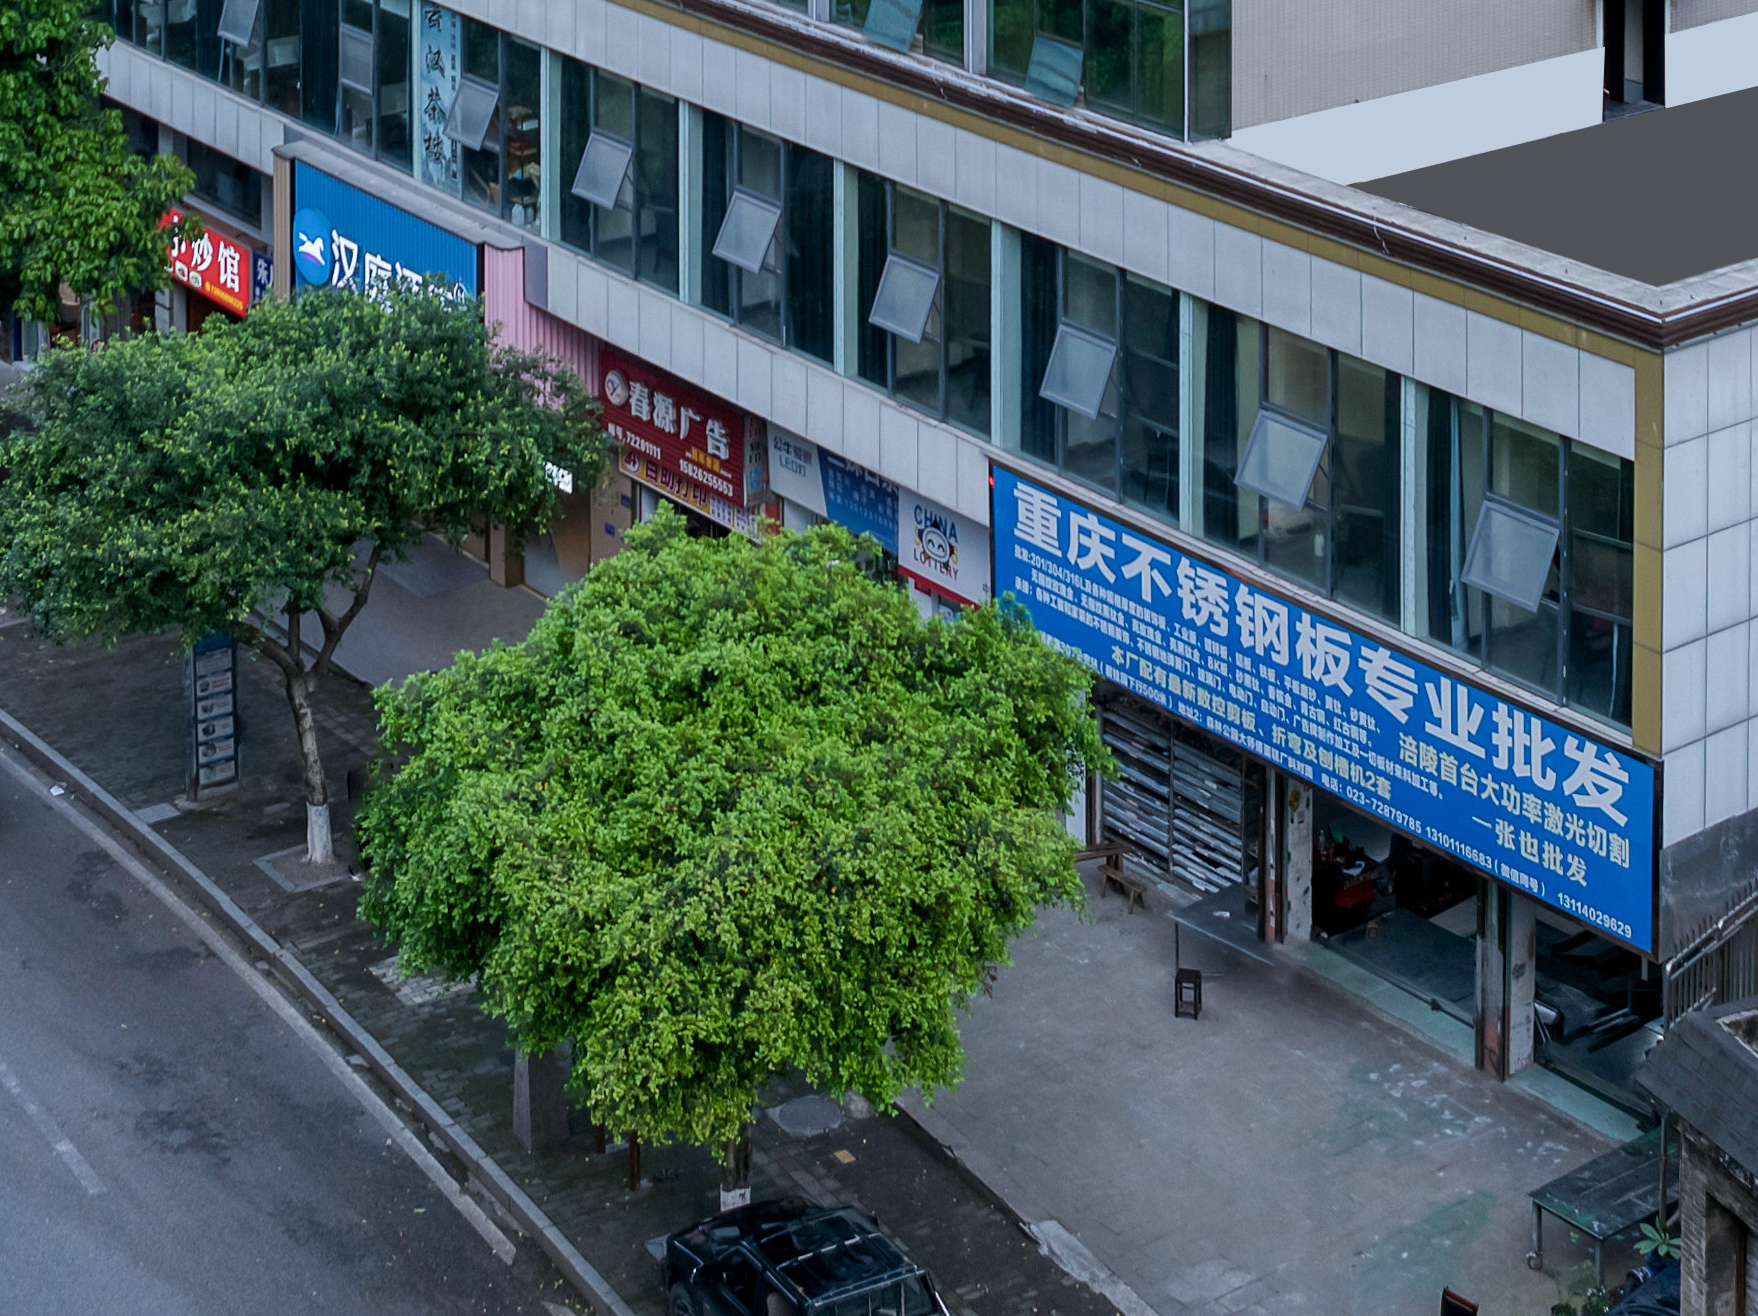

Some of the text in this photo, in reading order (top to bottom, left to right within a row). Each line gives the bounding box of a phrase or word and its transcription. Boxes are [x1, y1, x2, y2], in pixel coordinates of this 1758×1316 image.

[331, 228, 455, 315] 汉庭酒
[628, 379, 731, 461] 春源广告
[1013, 481, 1630, 828] 重庆不锈钢板专业批发
[1398, 731, 1631, 869] 涪陵首台大功率激光切割
[1471, 814, 1589, 888] 一张也批发
[1556, 890, 1633, 940] 13114029629
